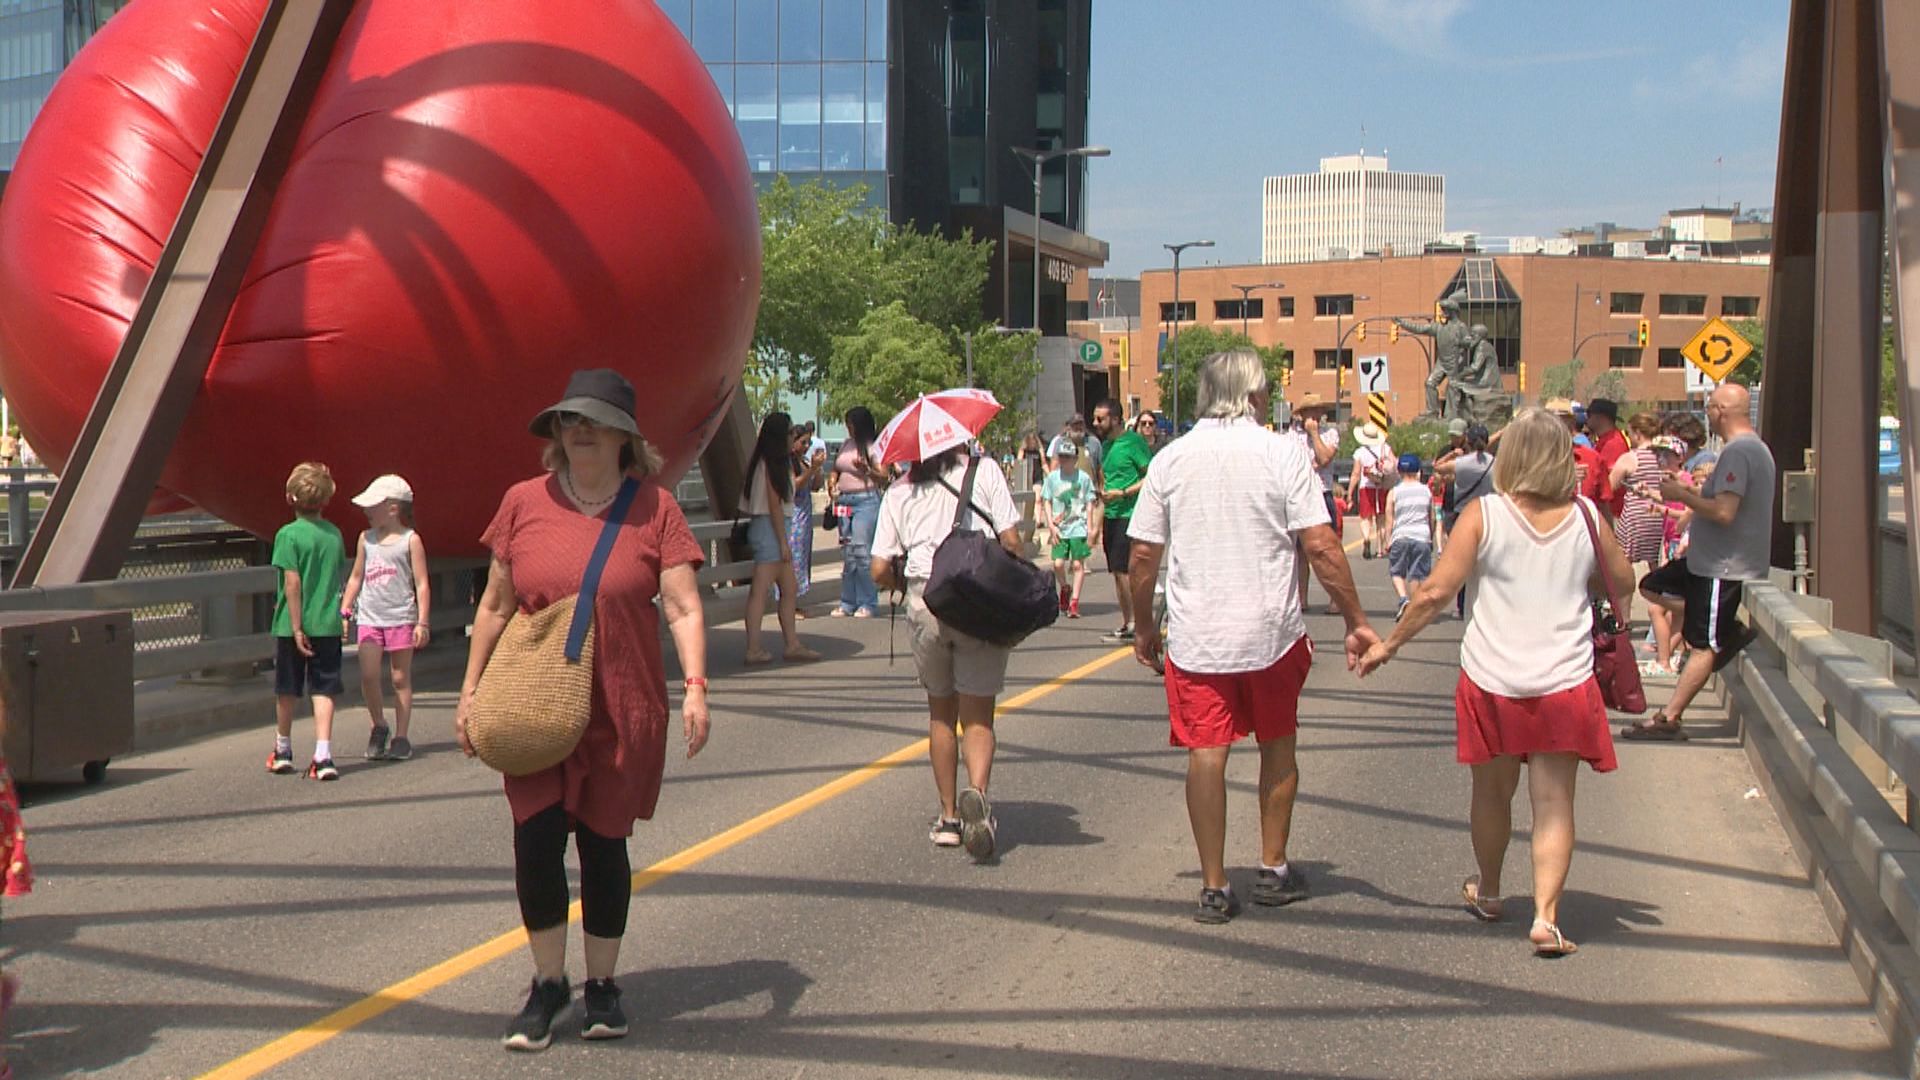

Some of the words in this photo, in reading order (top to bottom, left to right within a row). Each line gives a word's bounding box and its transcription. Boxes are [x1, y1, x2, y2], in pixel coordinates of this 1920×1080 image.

[1048, 258, 1060, 280] 409
[1061, 261, 1076, 284] EAST
[1085, 343, 1098, 361] P
